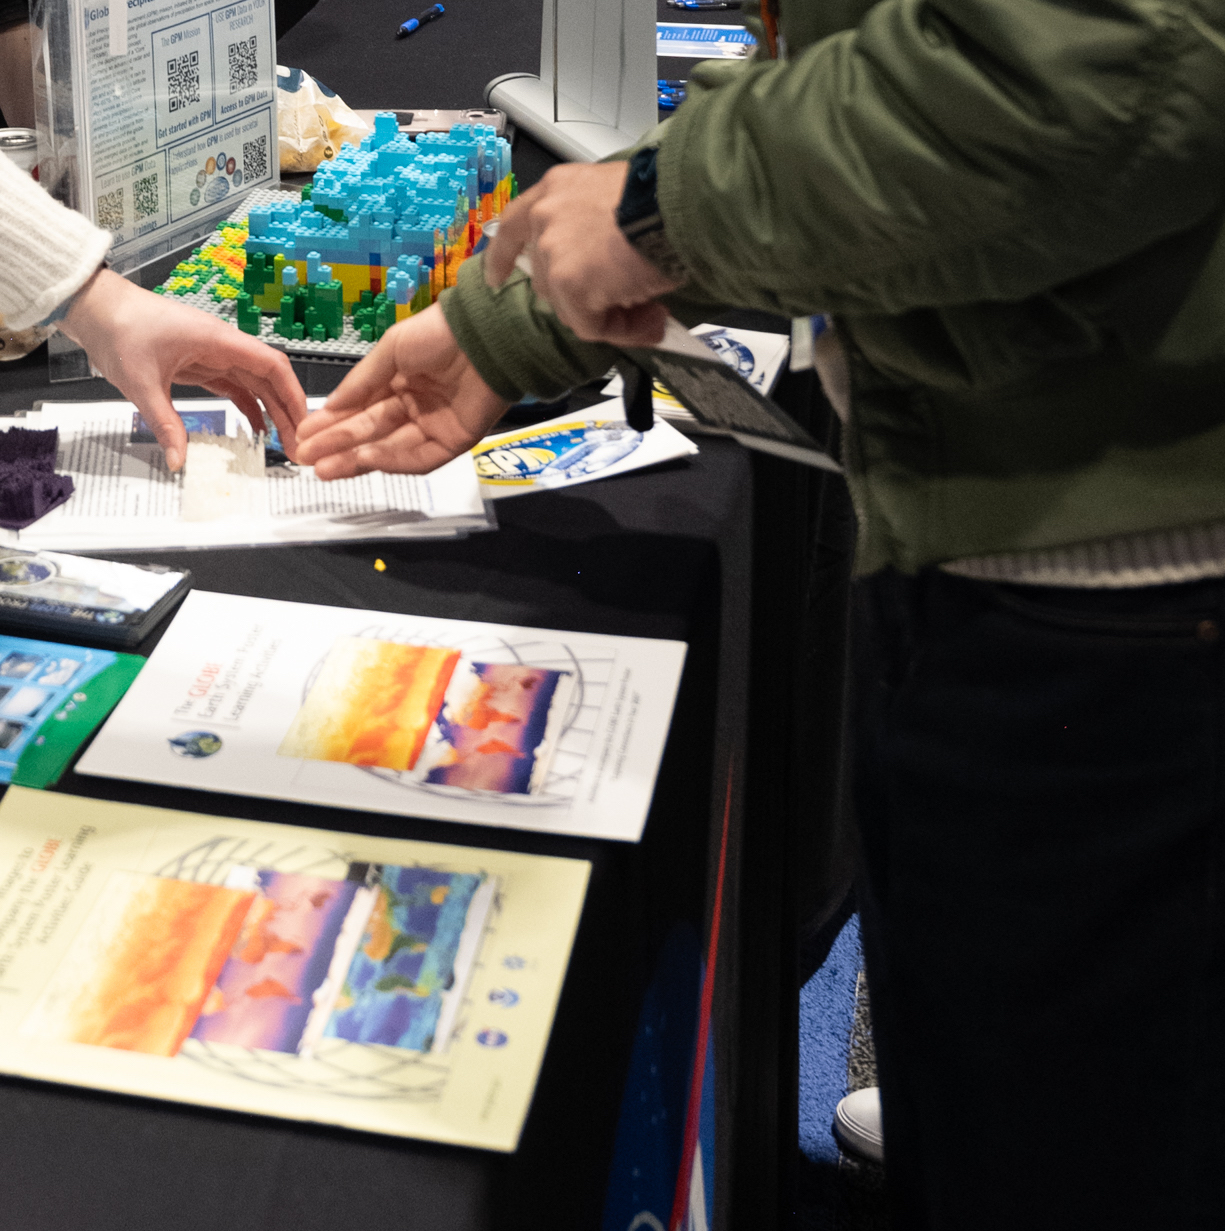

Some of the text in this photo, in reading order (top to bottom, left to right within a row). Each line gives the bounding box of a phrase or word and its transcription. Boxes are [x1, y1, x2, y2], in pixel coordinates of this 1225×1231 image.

[89, 5, 110, 21] Glob
[215, 12, 225, 23] USE
[225, 8, 237, 20] GPM
[237, 4, 247, 16] Data
[228, 14, 254, 31] RESEARCH
[161, 27, 201, 47] The GPM Mission
[220, 90, 268, 115] Access to GPM Data
[158, 109, 212, 139] Get started with GPM
[196, 137, 206, 150] how
[207, 133, 219, 147] GPM
[219, 130, 224, 141] is
[224, 128, 234, 140] used
[241, 119, 258, 133] societal
[131, 162, 144, 176] GPM
[144, 159, 156, 171] Data
[132, 221, 157, 237] Trainings
[475, 446, 557, 477] GPM
[177, 698, 192, 715] The
[200, 690, 223, 719] Earth
[227, 678, 259, 723] Learning
